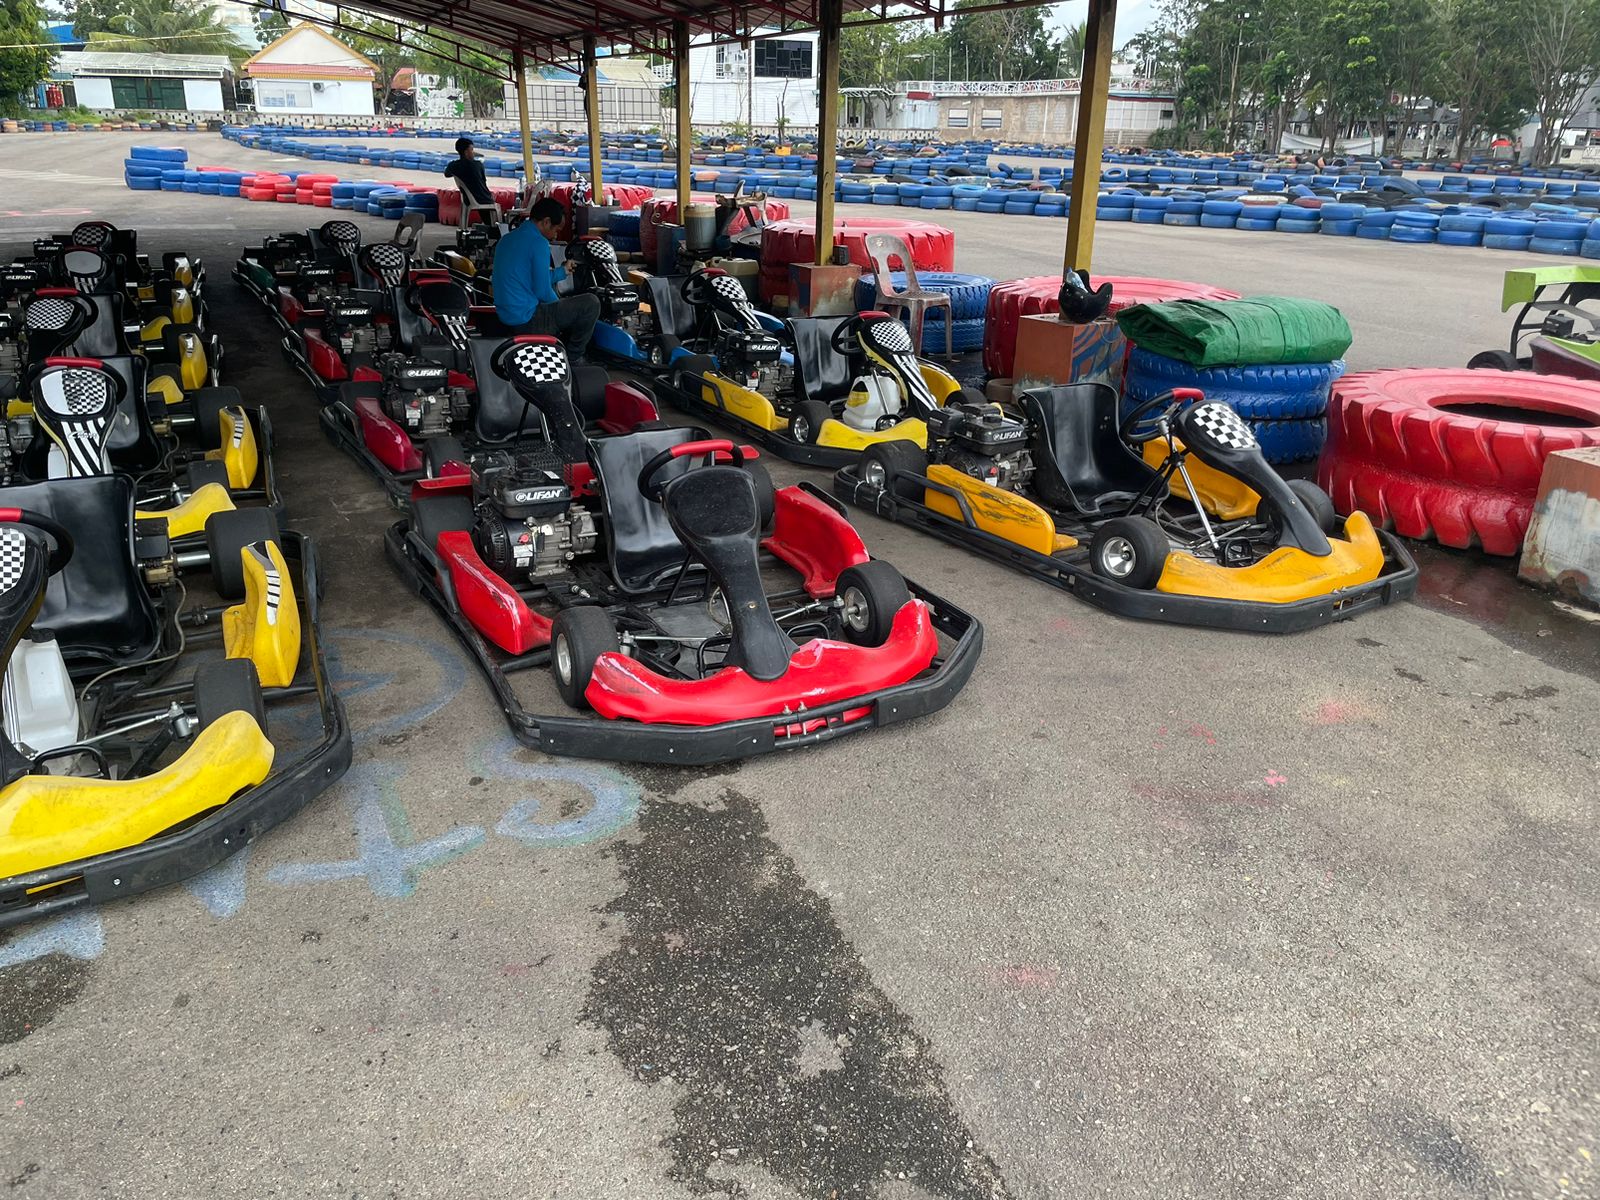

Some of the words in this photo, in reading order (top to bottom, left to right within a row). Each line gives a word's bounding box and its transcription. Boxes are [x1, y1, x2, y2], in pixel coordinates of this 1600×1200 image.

[414, 368, 443, 377] LIFAN
[1000, 430, 1022, 440] LIFAN
[527, 490, 561, 501] LIFAN
